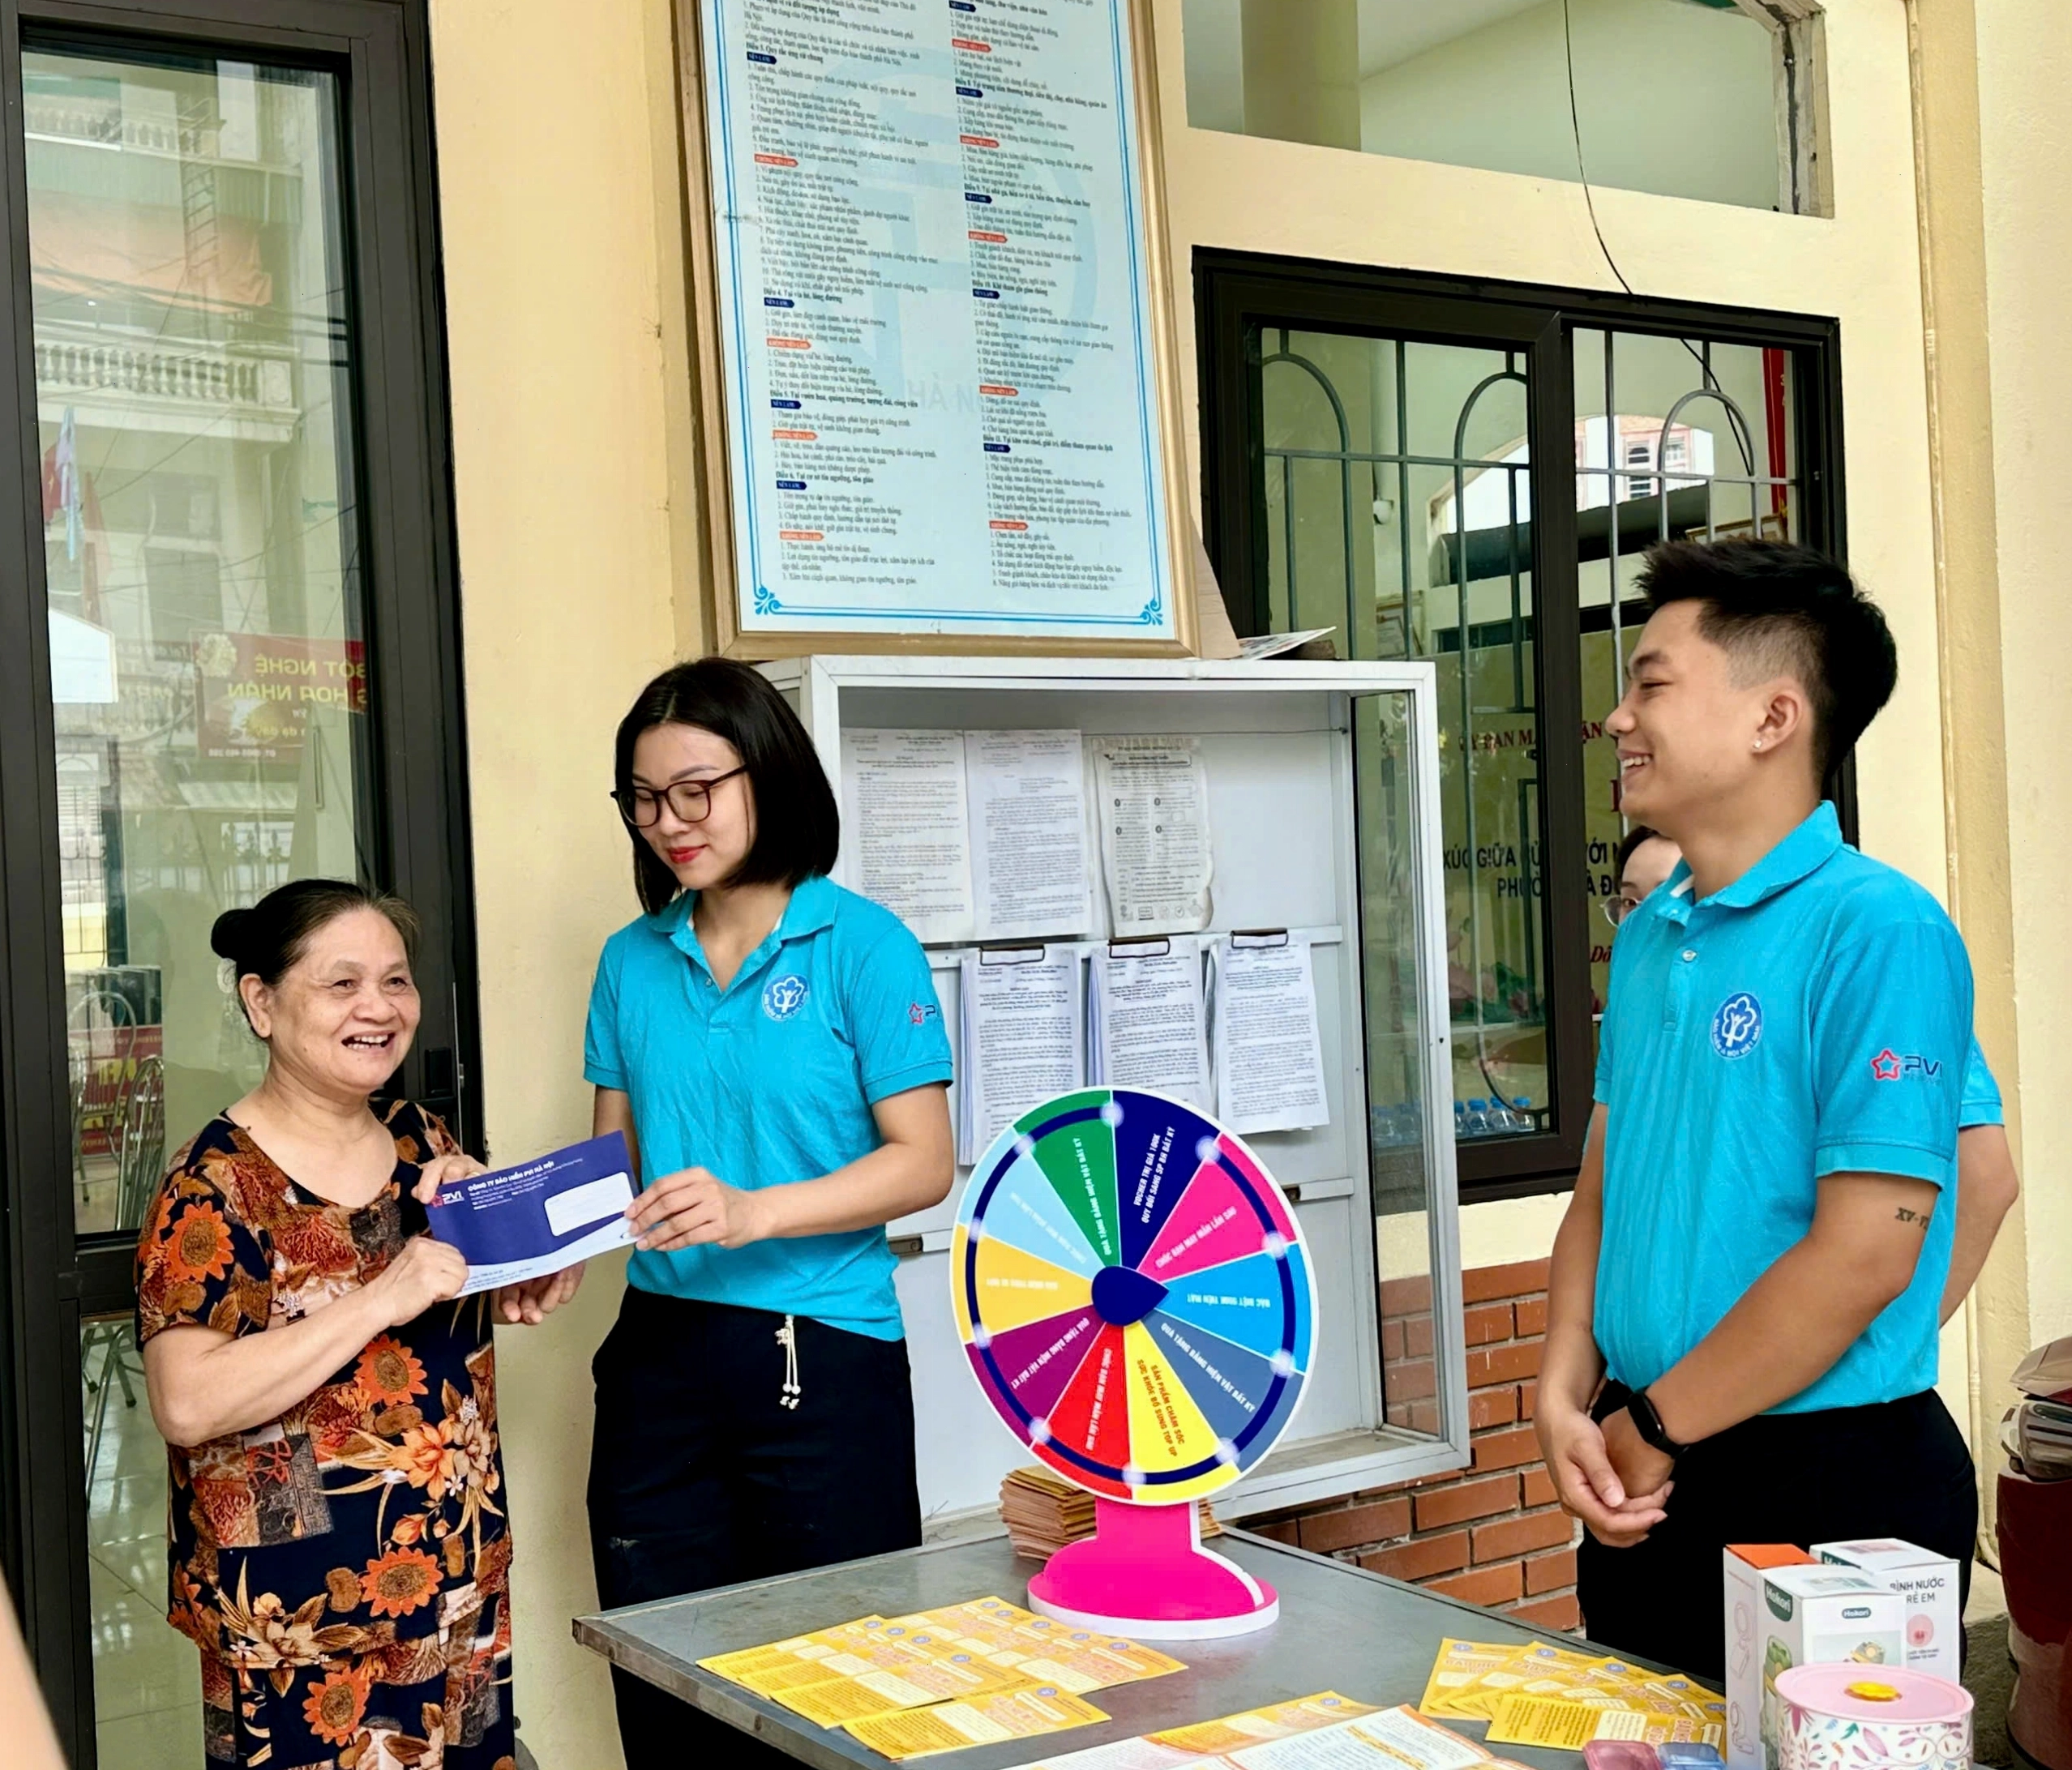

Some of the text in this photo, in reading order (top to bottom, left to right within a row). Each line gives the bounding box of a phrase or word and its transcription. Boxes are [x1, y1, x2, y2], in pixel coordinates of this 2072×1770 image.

[442, 1191, 463, 1201] PVI
[1916, 1575, 1945, 1590] NƯỚC
[1921, 1592, 1935, 1603] EM
